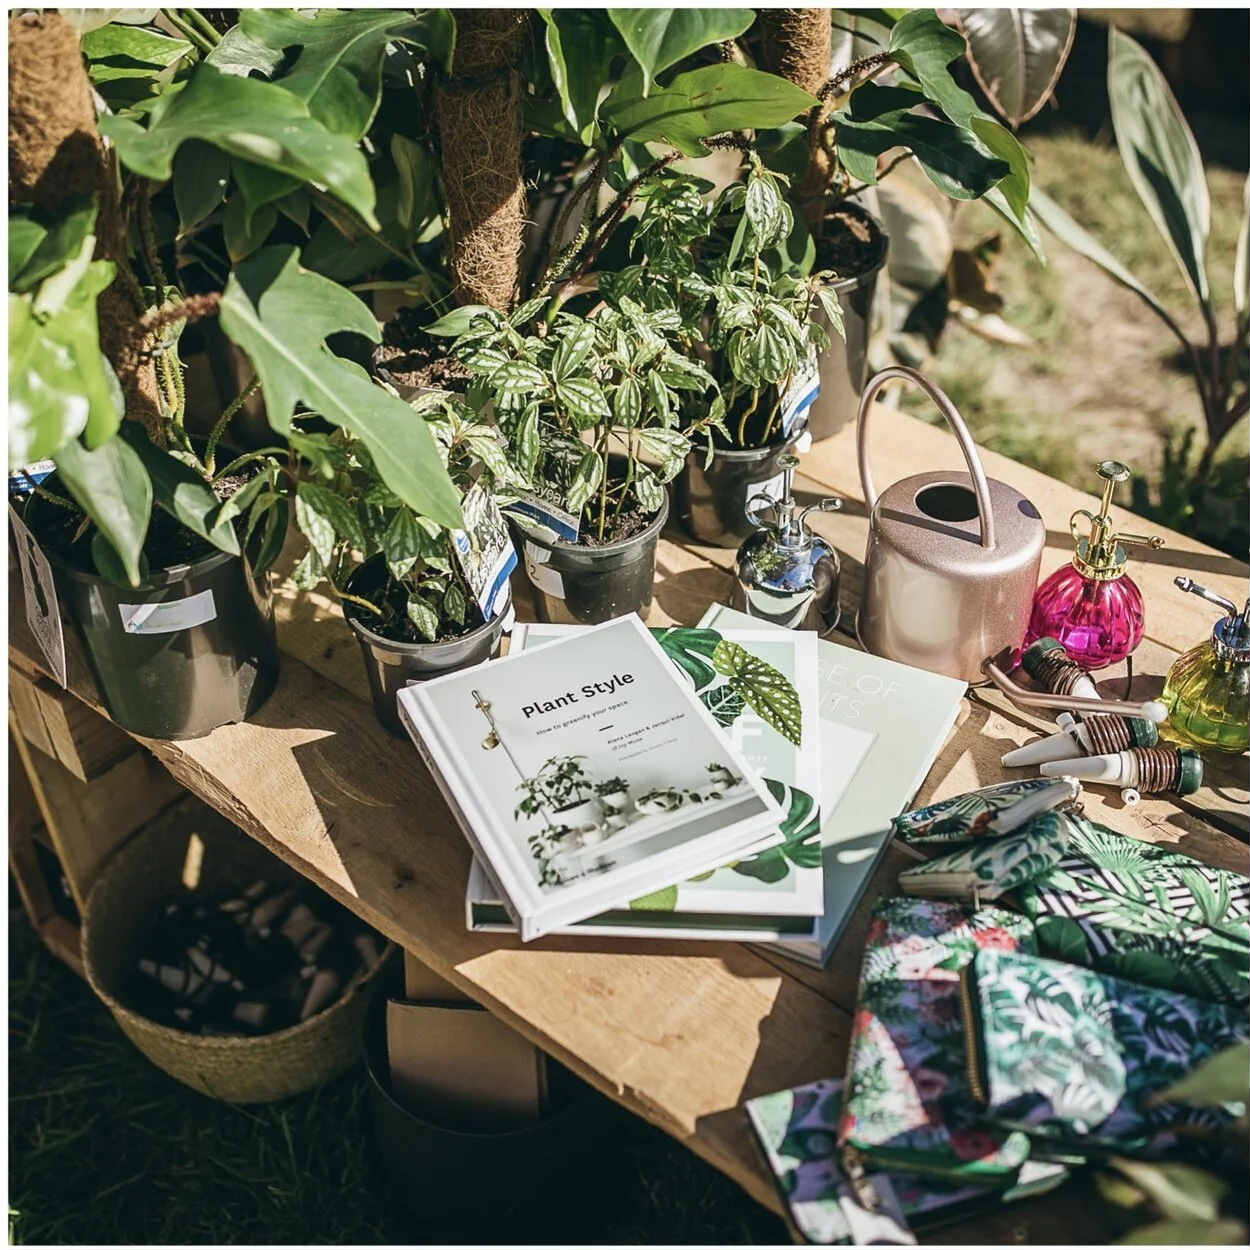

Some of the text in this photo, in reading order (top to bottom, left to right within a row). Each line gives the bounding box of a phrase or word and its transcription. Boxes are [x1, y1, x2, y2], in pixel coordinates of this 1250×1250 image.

[522, 673, 635, 719] Plant Style
[857, 675, 905, 699] OF
[536, 700, 629, 736] How to greenify your space
